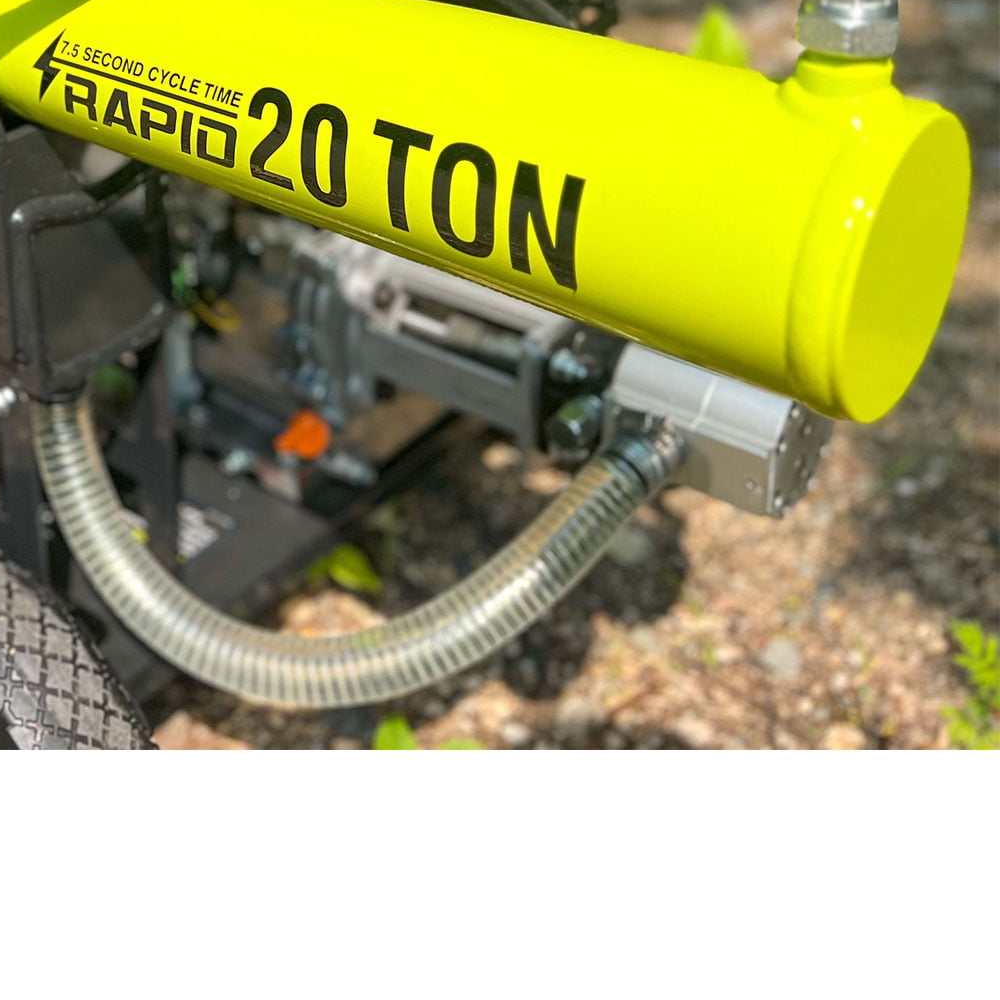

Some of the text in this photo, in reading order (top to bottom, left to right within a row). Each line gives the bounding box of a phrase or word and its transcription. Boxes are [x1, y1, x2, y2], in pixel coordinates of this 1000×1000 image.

[60, 40, 243, 108] 7.5 SECOND CYCLE TIME
[64, 73, 587, 293] RAPID 20 TON
